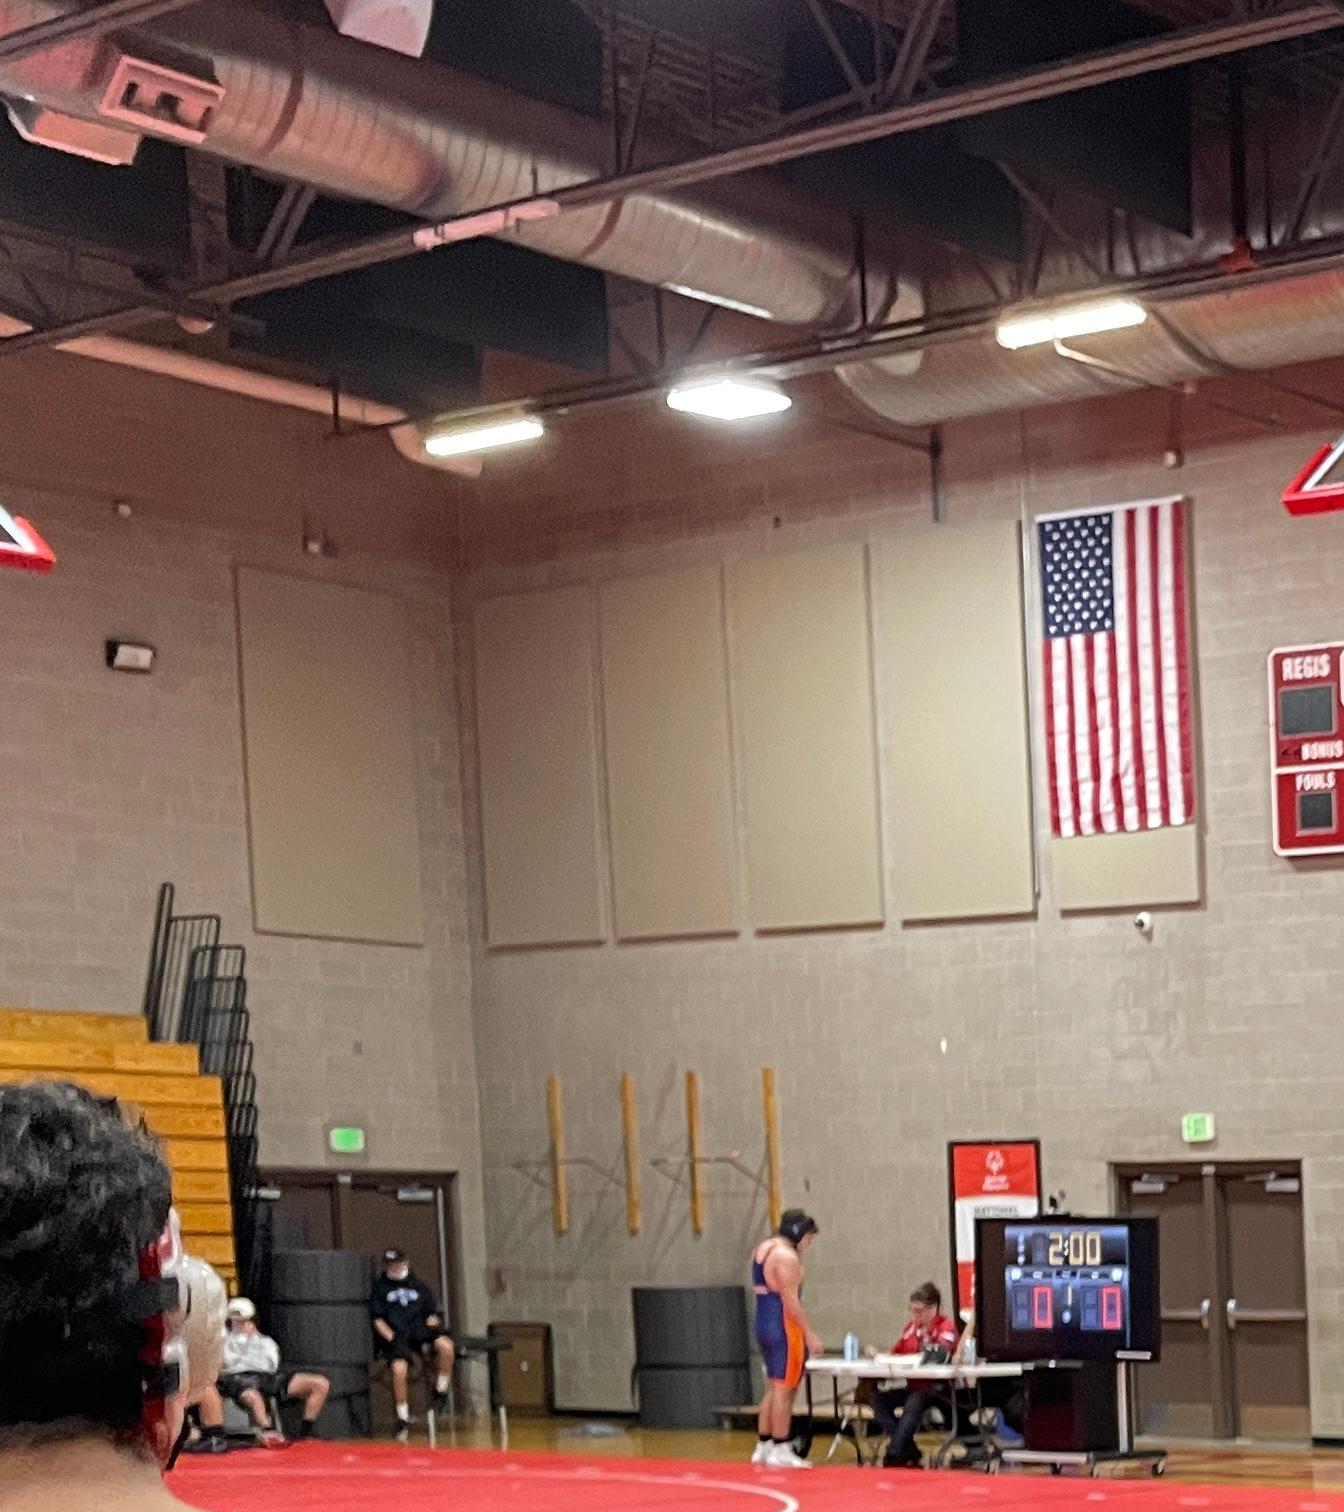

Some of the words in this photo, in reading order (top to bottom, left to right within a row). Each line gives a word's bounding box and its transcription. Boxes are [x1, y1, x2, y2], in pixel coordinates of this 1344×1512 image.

[1281, 653, 1331, 681] REGIS
[1300, 740, 1344, 761] BONUS
[1295, 771, 1336, 791] FOULS
[1049, 1231, 1101, 1266] 2:00
[1032, 1285, 1053, 1329] 0
[1102, 1285, 1122, 1330] 0
